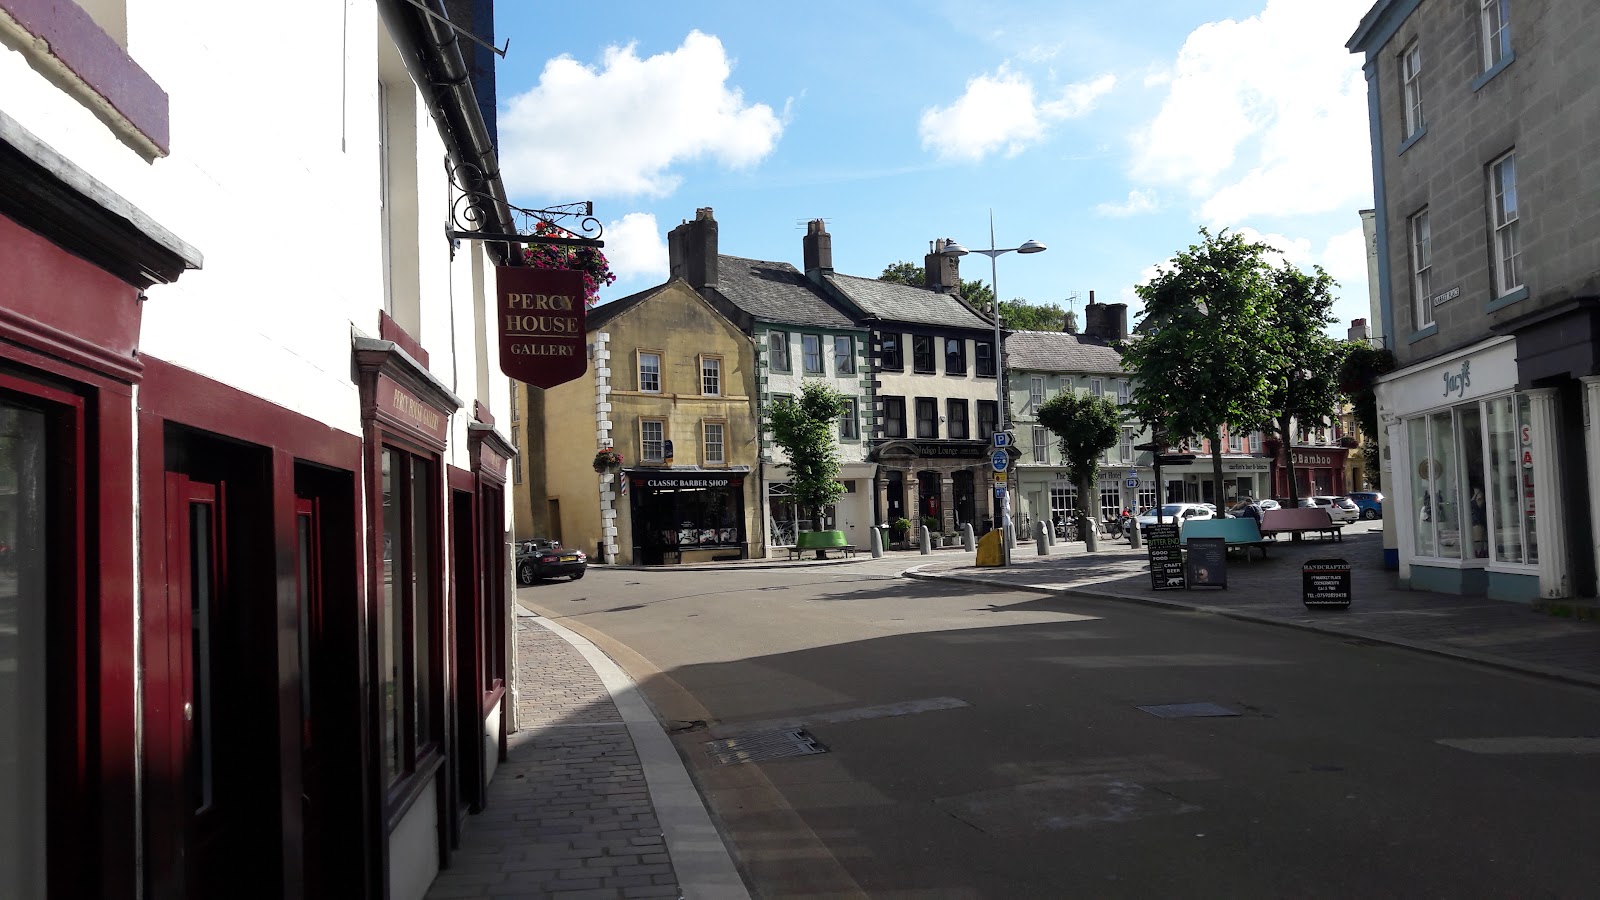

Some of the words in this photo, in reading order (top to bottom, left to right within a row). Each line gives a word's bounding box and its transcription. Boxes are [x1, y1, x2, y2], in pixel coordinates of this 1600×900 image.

[507, 293, 576, 311] PERCY
[505, 315, 578, 333] HOUSE
[510, 343, 576, 356] GALLERY
[393, 388, 408, 414] PERCY
[408, 398, 423, 422] HOUSE
[423, 407, 438, 431] GALLERY
[998, 436, 1004, 444] P
[918, 445, 936, 456] Indigo
[938, 446, 958, 456] Lounge
[1298, 454, 1331, 464] Bamboo
